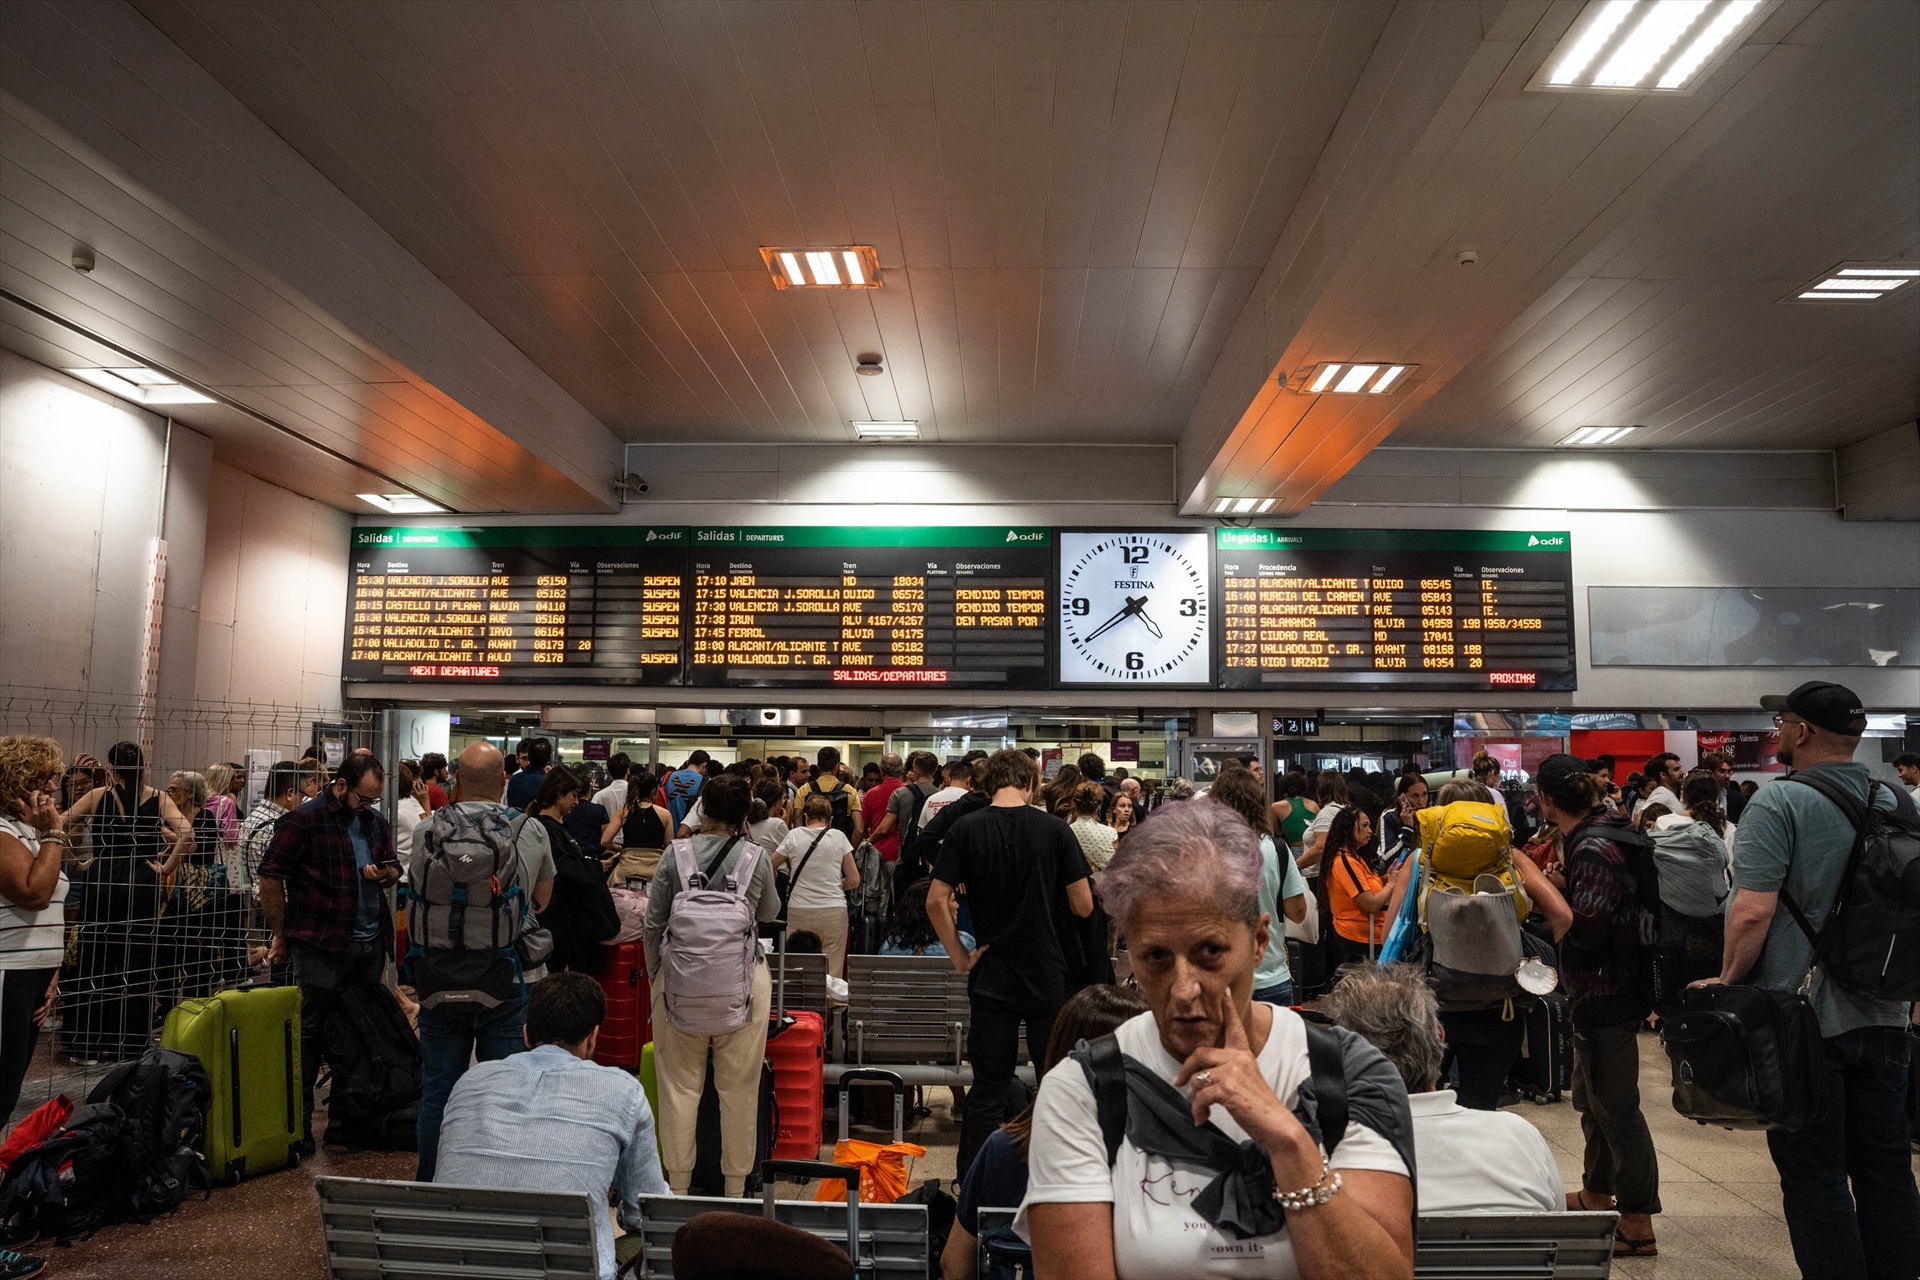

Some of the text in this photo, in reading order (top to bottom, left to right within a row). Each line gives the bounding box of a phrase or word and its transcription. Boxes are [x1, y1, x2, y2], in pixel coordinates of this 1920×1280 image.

[359, 533, 393, 543] Salidas
[698, 531, 734, 540] Salidas
[1019, 532, 1044, 540] adif
[1223, 533, 1267, 544] Llegadas
[1120, 546, 1149, 564] 12
[357, 576, 680, 586] 15:30 VALENCIA J.SOROLLA AVE 05150 SUSPEN
[697, 576, 924, 586] 17:10 JAEN 18034
[1114, 581, 1154, 589] FESTINA
[1225, 578, 1451, 589] 16:23 ALACANT/ALICANTE OUIGO 06545
[356, 588, 680, 598] 16:00 ALACANT/ALICANTE AVE 05162 SUSPEN
[696, 589, 726, 598] 17:15
[730, 589, 778, 599] VALENCIA
[784, 589, 840, 599] J.SOROLLA
[843, 590, 874, 599] OUIGO
[893, 590, 924, 599] 06572
[956, 590, 1000, 599] PENDIDO
[1225, 591, 1452, 602] 16:40 MURCIA DEL CARMEN AVE 05843
[355, 601, 679, 611] 16:15 CASTELLO PLANA ALVIA 04110 SUSPEN
[696, 602, 726, 611] 17:30
[730, 602, 778, 612] VALENCIA
[784, 602, 839, 612] J.SOROLLA
[843, 603, 862, 612] AVE
[892, 603, 924, 612] 05170
[956, 603, 1000, 612] PENDIDO
[1072, 598, 1089, 616] 9
[1180, 599, 1197, 616] 3
[1226, 604, 1452, 615] 17:08 ALACANT/ALICANTE AVE 05143
[354, 614, 679, 624] 16:30 VALENCIA J.SOROLLA AVE 05160 SUSPEN
[696, 615, 1037, 626] 17:38 IRUN ALV 4167/4267 PASAR POR
[1226, 618, 1256, 627] 17:11
[1260, 618, 1316, 628] SALAMANCA
[1374, 618, 1405, 628] ALVIA
[1422, 619, 1452, 628] 04958
[1463, 619, 1480, 628] 19B
[353, 626, 678, 637] 16:45 ALACANT/ALICANTE IRYO 06164 SUSPEN
[695, 628, 923, 638] 17:45 FERROL ALVIA 04175
[1226, 631, 1453, 641] 17:17 CIUDAD REAL 17041
[353, 638, 564, 649] 17:00 VALLADOLID GR. AVANT 08179
[694, 641, 923, 652] 18:00 ALACANT/ALICANTE AVE 05182
[1226, 644, 1481, 654] 17:27 VALLADOLID AVANT 08168 18B
[352, 651, 677, 663] 17:00 ALACANT/ALICANTE AVLO 05178 SUSPEN
[694, 654, 923, 665] 18:10 VALLADOLID AVANT 08389
[1126, 652, 1144, 670] 6
[1226, 657, 1454, 668] 17:36 VIGO URZAIZ ALVIA 04354
[413, 666, 498, 676] NEXT DEPARTURES
[834, 671, 946, 681] SALIDAS/DEPARTURES
[1722, 745, 1735, 758] 18€
[1184, 1222, 1207, 1231] you
